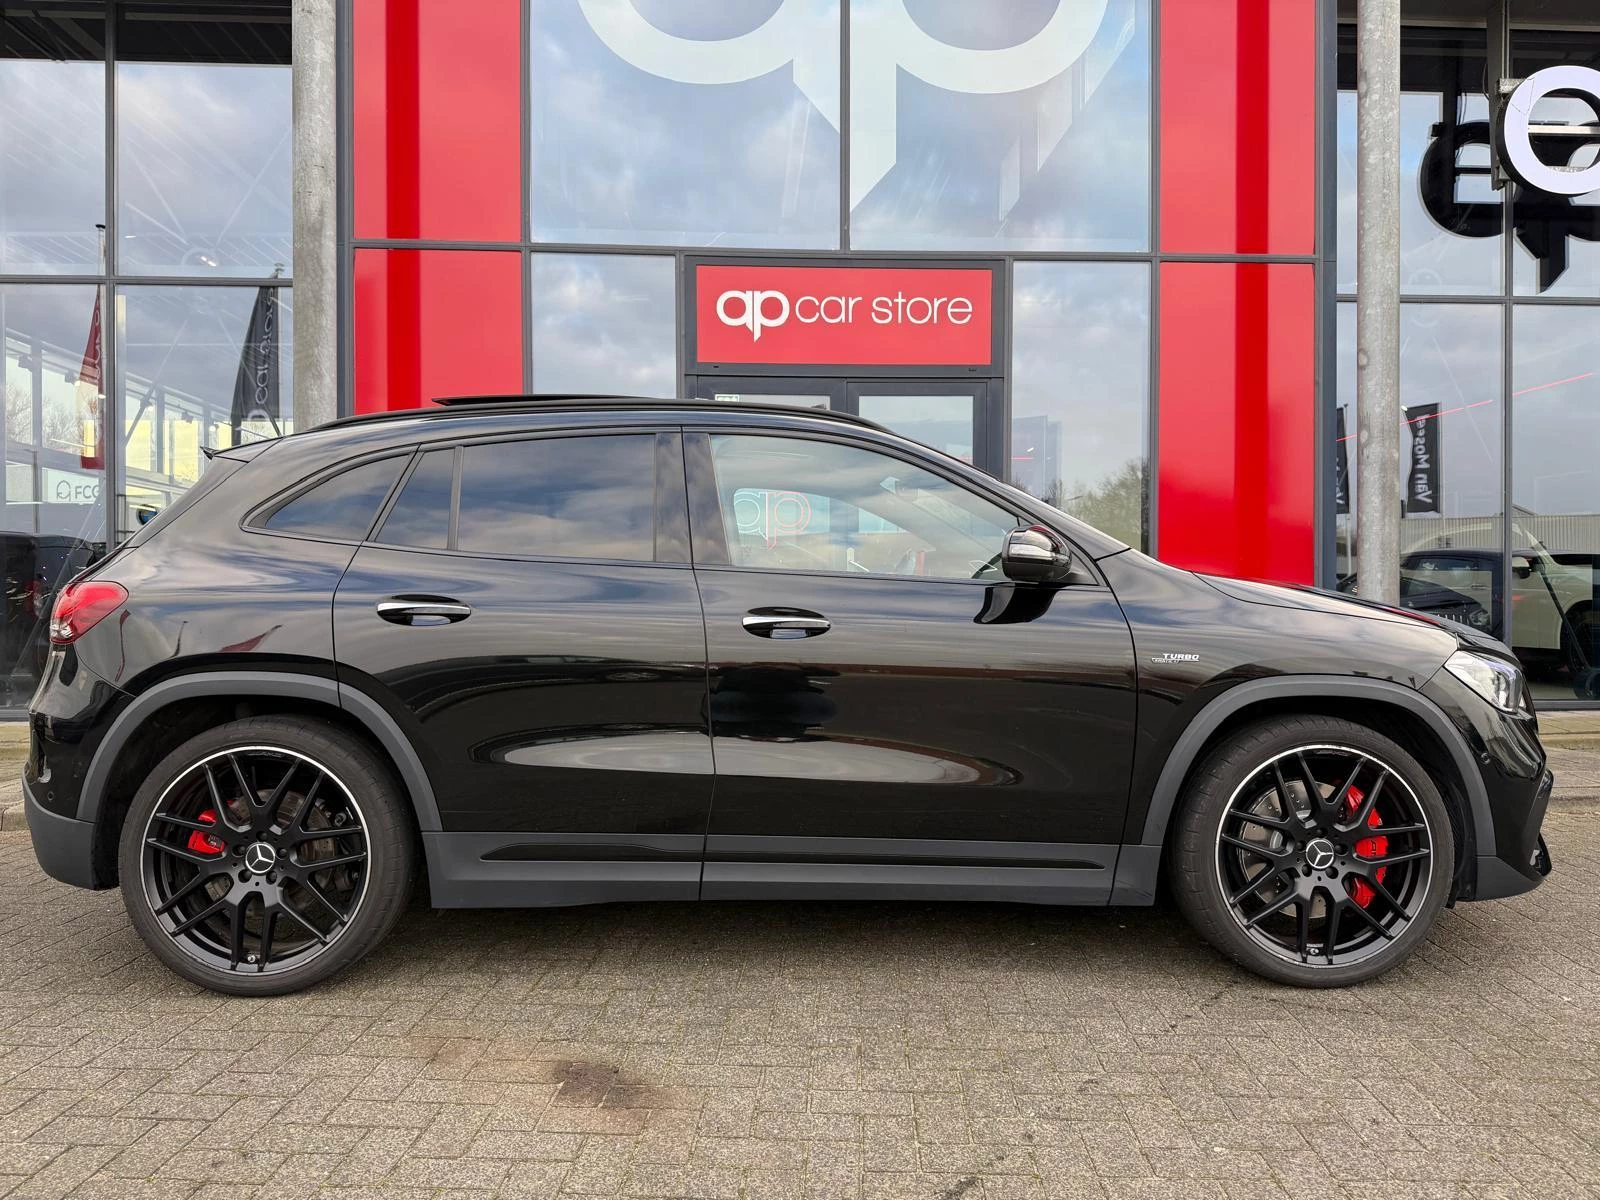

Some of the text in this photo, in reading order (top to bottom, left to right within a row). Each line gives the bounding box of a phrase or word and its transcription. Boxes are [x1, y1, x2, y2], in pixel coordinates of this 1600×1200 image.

[716, 290, 973, 342] ap car store
[1162, 653, 1200, 661] TURBO
